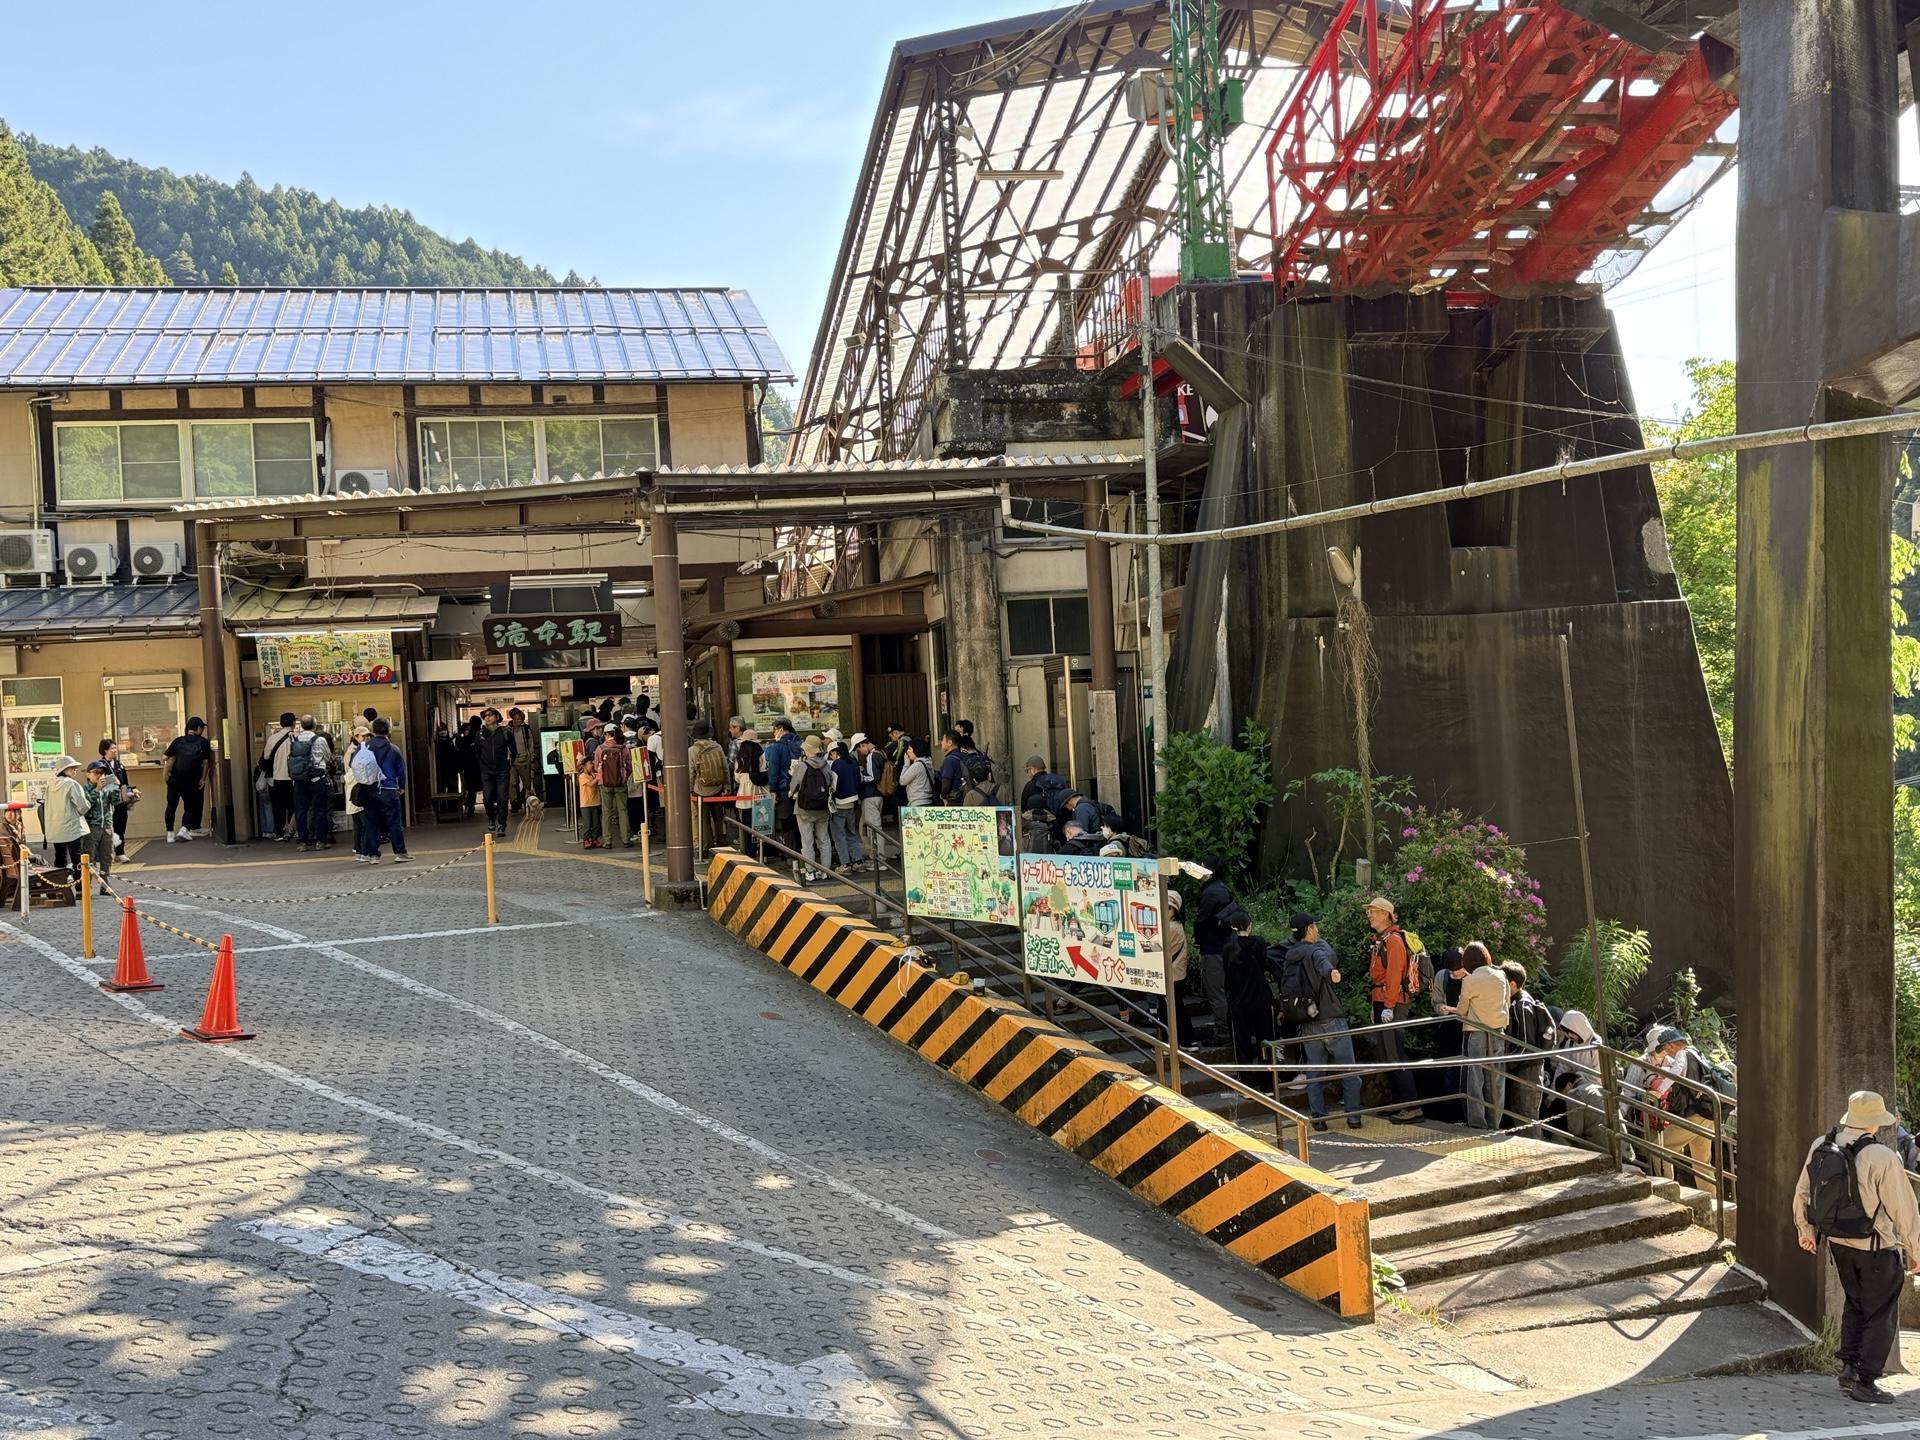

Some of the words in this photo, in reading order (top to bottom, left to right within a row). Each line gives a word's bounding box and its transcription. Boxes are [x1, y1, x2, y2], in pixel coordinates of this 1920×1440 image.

[492, 619, 607, 648] 滝本駅
[290, 673, 369, 686] きっぷうりば
[1026, 934, 1060, 956] ようこそ
[1102, 956, 1126, 982] すぐ
